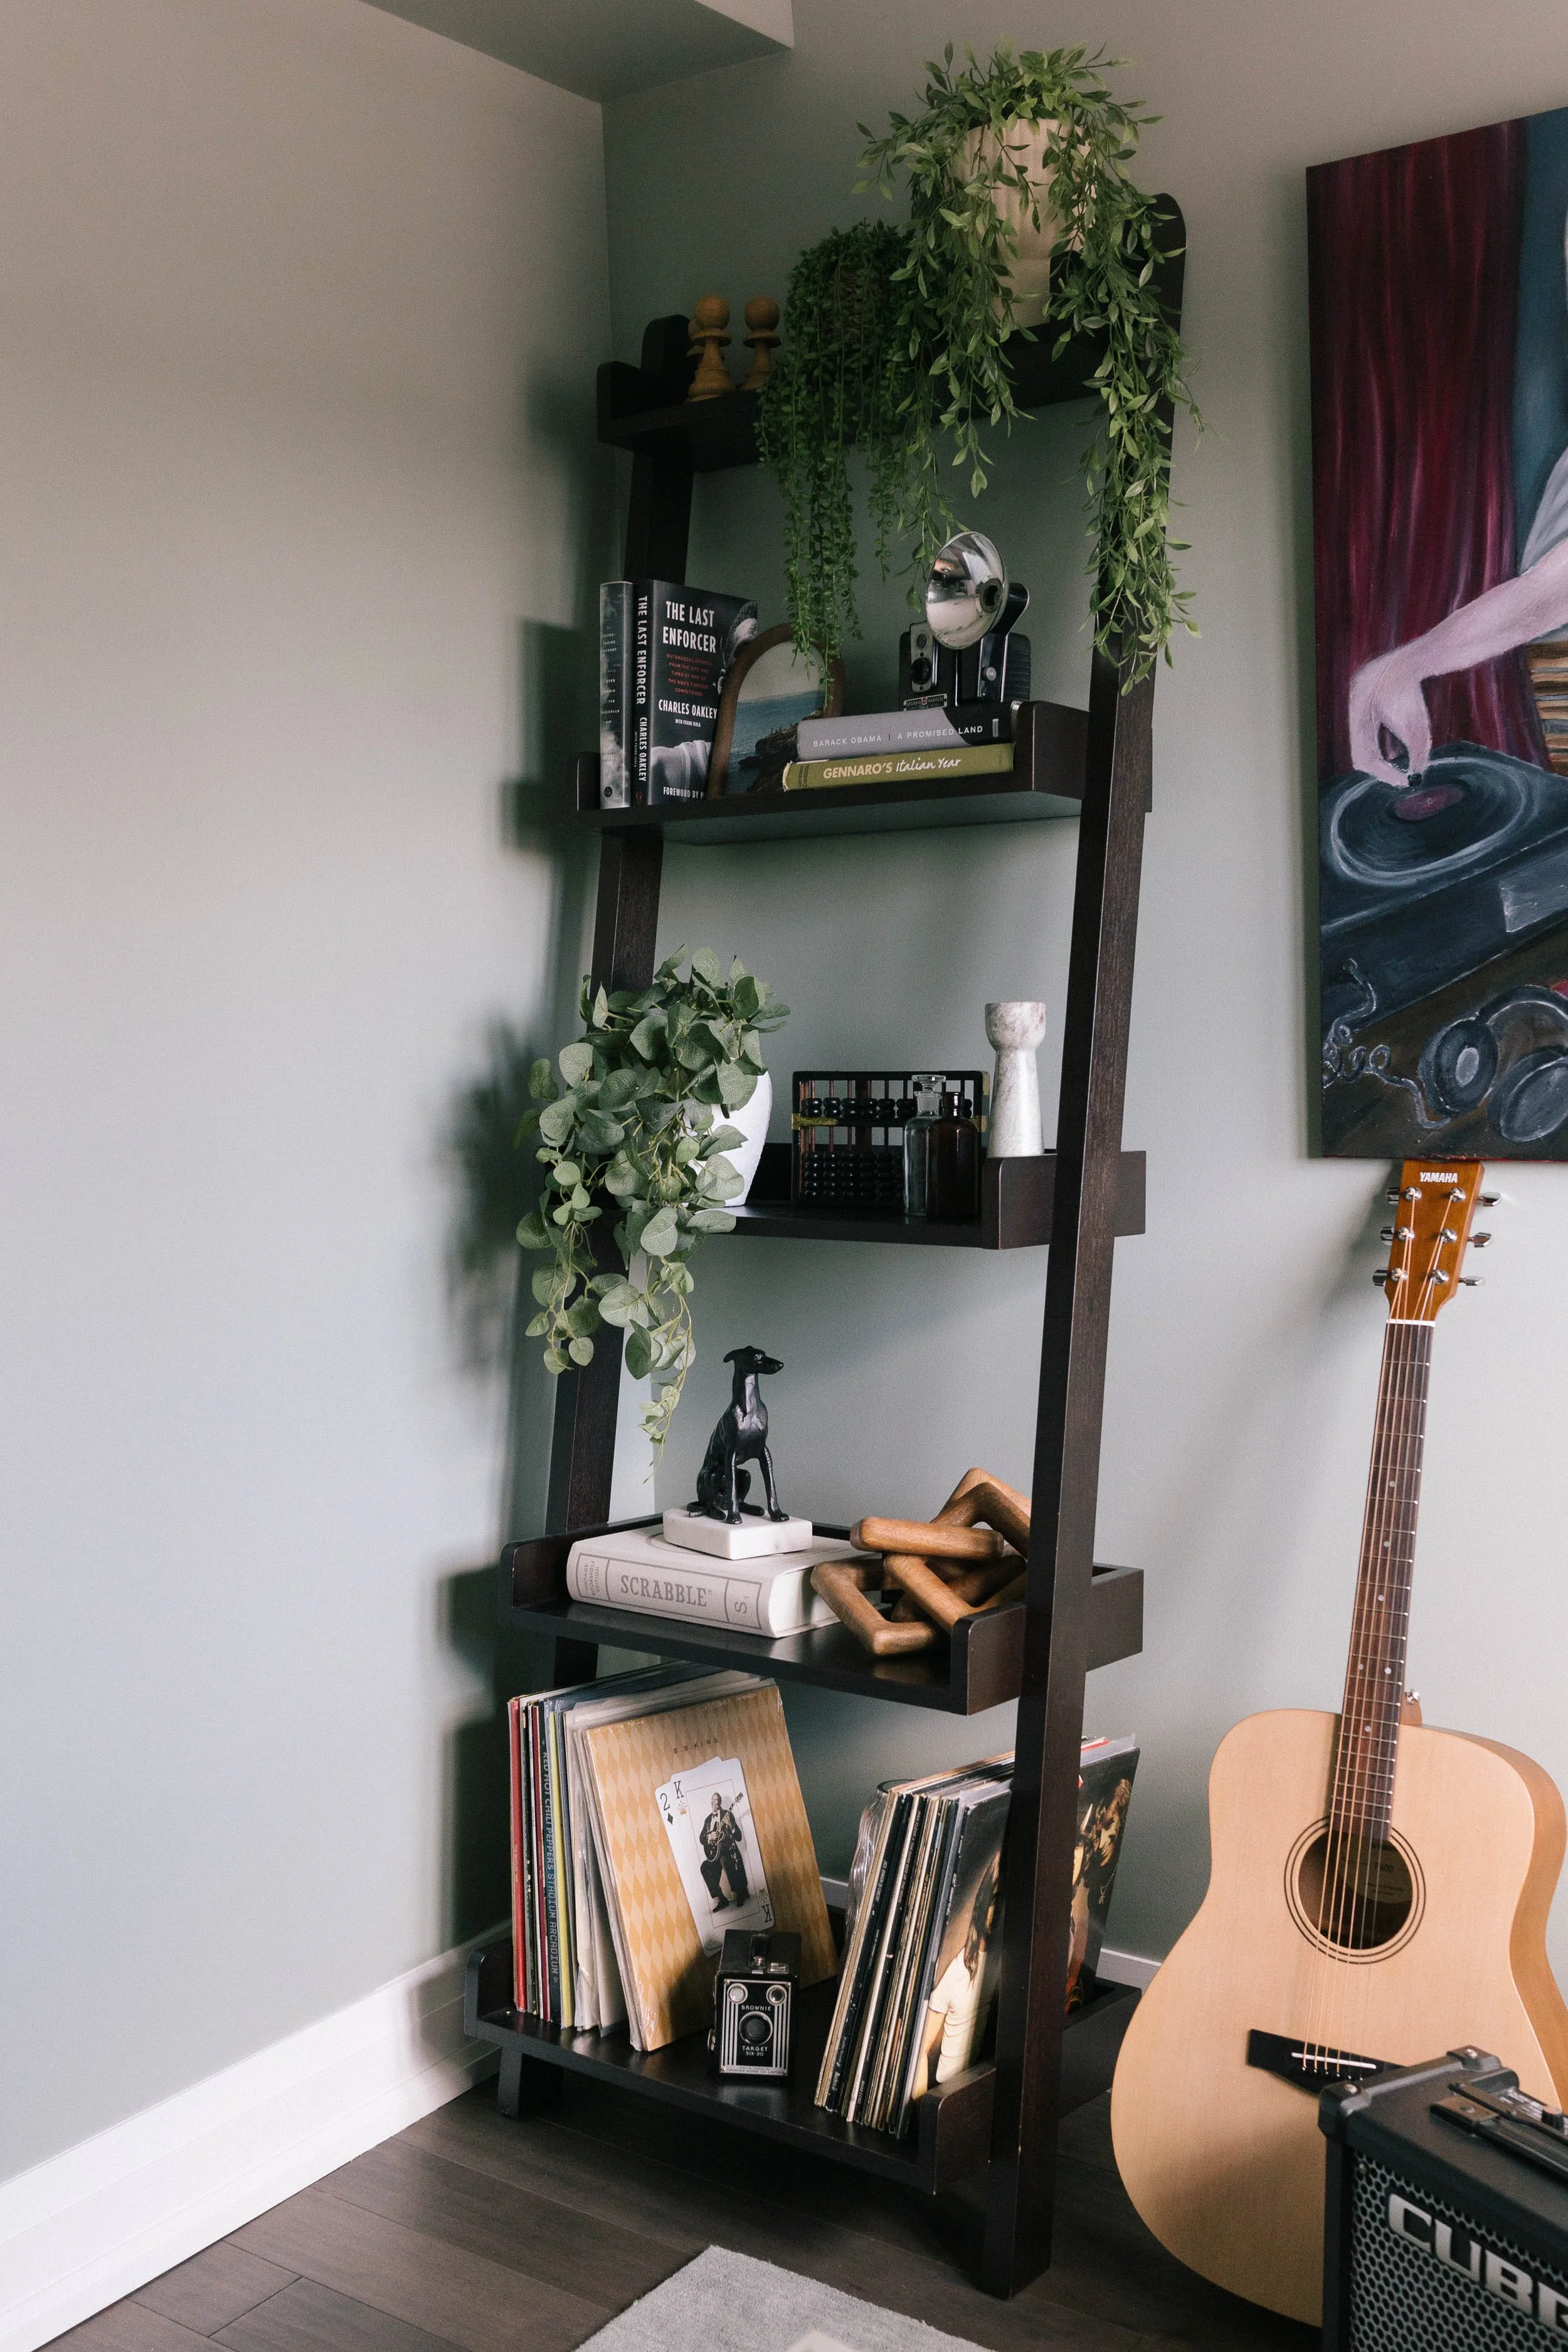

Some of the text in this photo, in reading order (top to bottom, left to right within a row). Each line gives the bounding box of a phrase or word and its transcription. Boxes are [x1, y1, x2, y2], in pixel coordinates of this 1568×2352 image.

[666, 600, 714, 627] THE LAST
[637, 595, 647, 705] THE LAST ENFORCER
[663, 626, 716, 654] ENFORCER
[659, 699, 718, 719] CHARLES OAKLEY
[813, 734, 882, 748] BARACK OBAMA
[907, 728, 955, 739] PROMISED
[958, 726, 983, 734] LAND
[638, 717, 647, 781] CHARLES OAKLEY
[824, 757, 961, 779] GENNARO'S Italian Year
[663, 787, 691, 798] FOREWORD
[692, 790, 699, 799] BY
[1420, 1172, 1458, 1183] YAMAHA
[621, 1574, 707, 1607] SCRABBLE
[674, 1780, 684, 1799] K
[545, 1798, 553, 1825] CHILI
[660, 1793, 670, 1811] 2
[546, 1829, 555, 1870] PEPPERS
[548, 1873, 556, 1918] STADIUM
[762, 1904, 773, 1923] K
[549, 1922, 559, 1974] ARCADIUM
